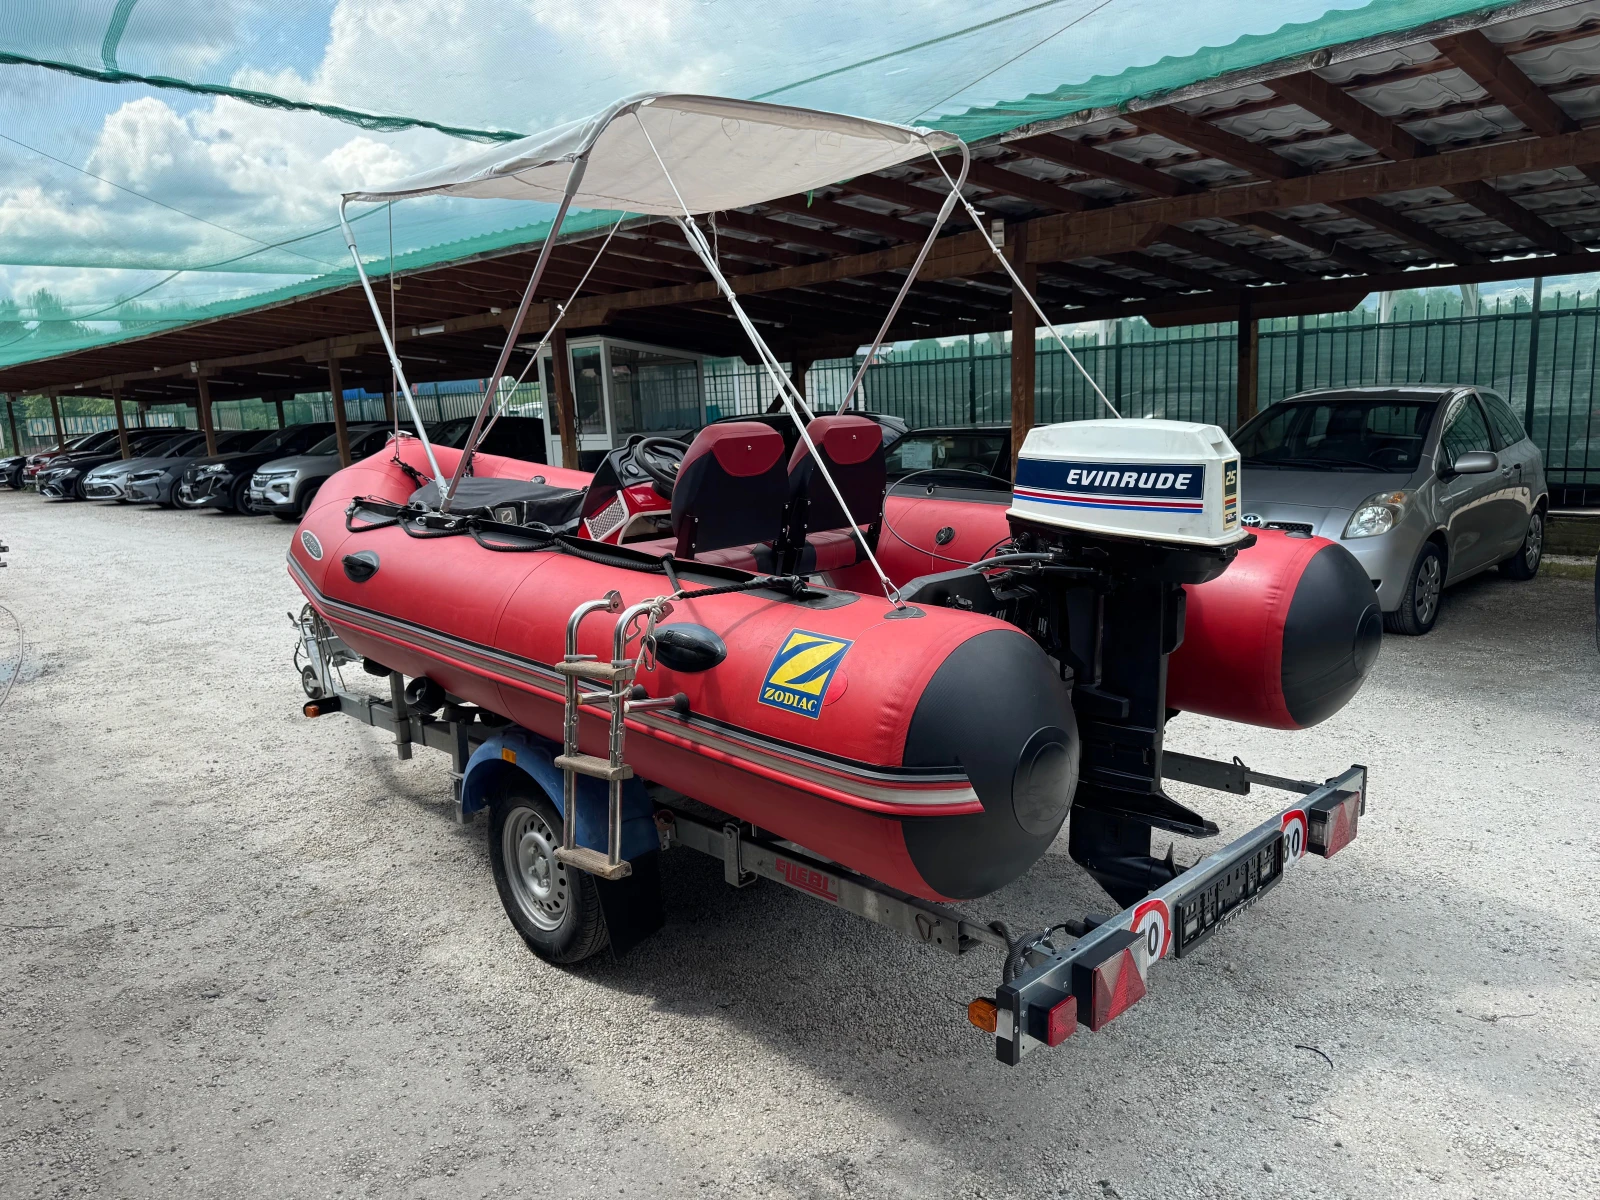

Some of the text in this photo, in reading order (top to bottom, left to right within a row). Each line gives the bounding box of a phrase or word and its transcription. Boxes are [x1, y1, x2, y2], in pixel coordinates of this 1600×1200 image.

[1066, 469, 1193, 490] EVINRUDE
[1225, 470, 1237, 486] 25
[763, 686, 817, 712] ZODIAC
[1148, 922, 1159, 957] 0
